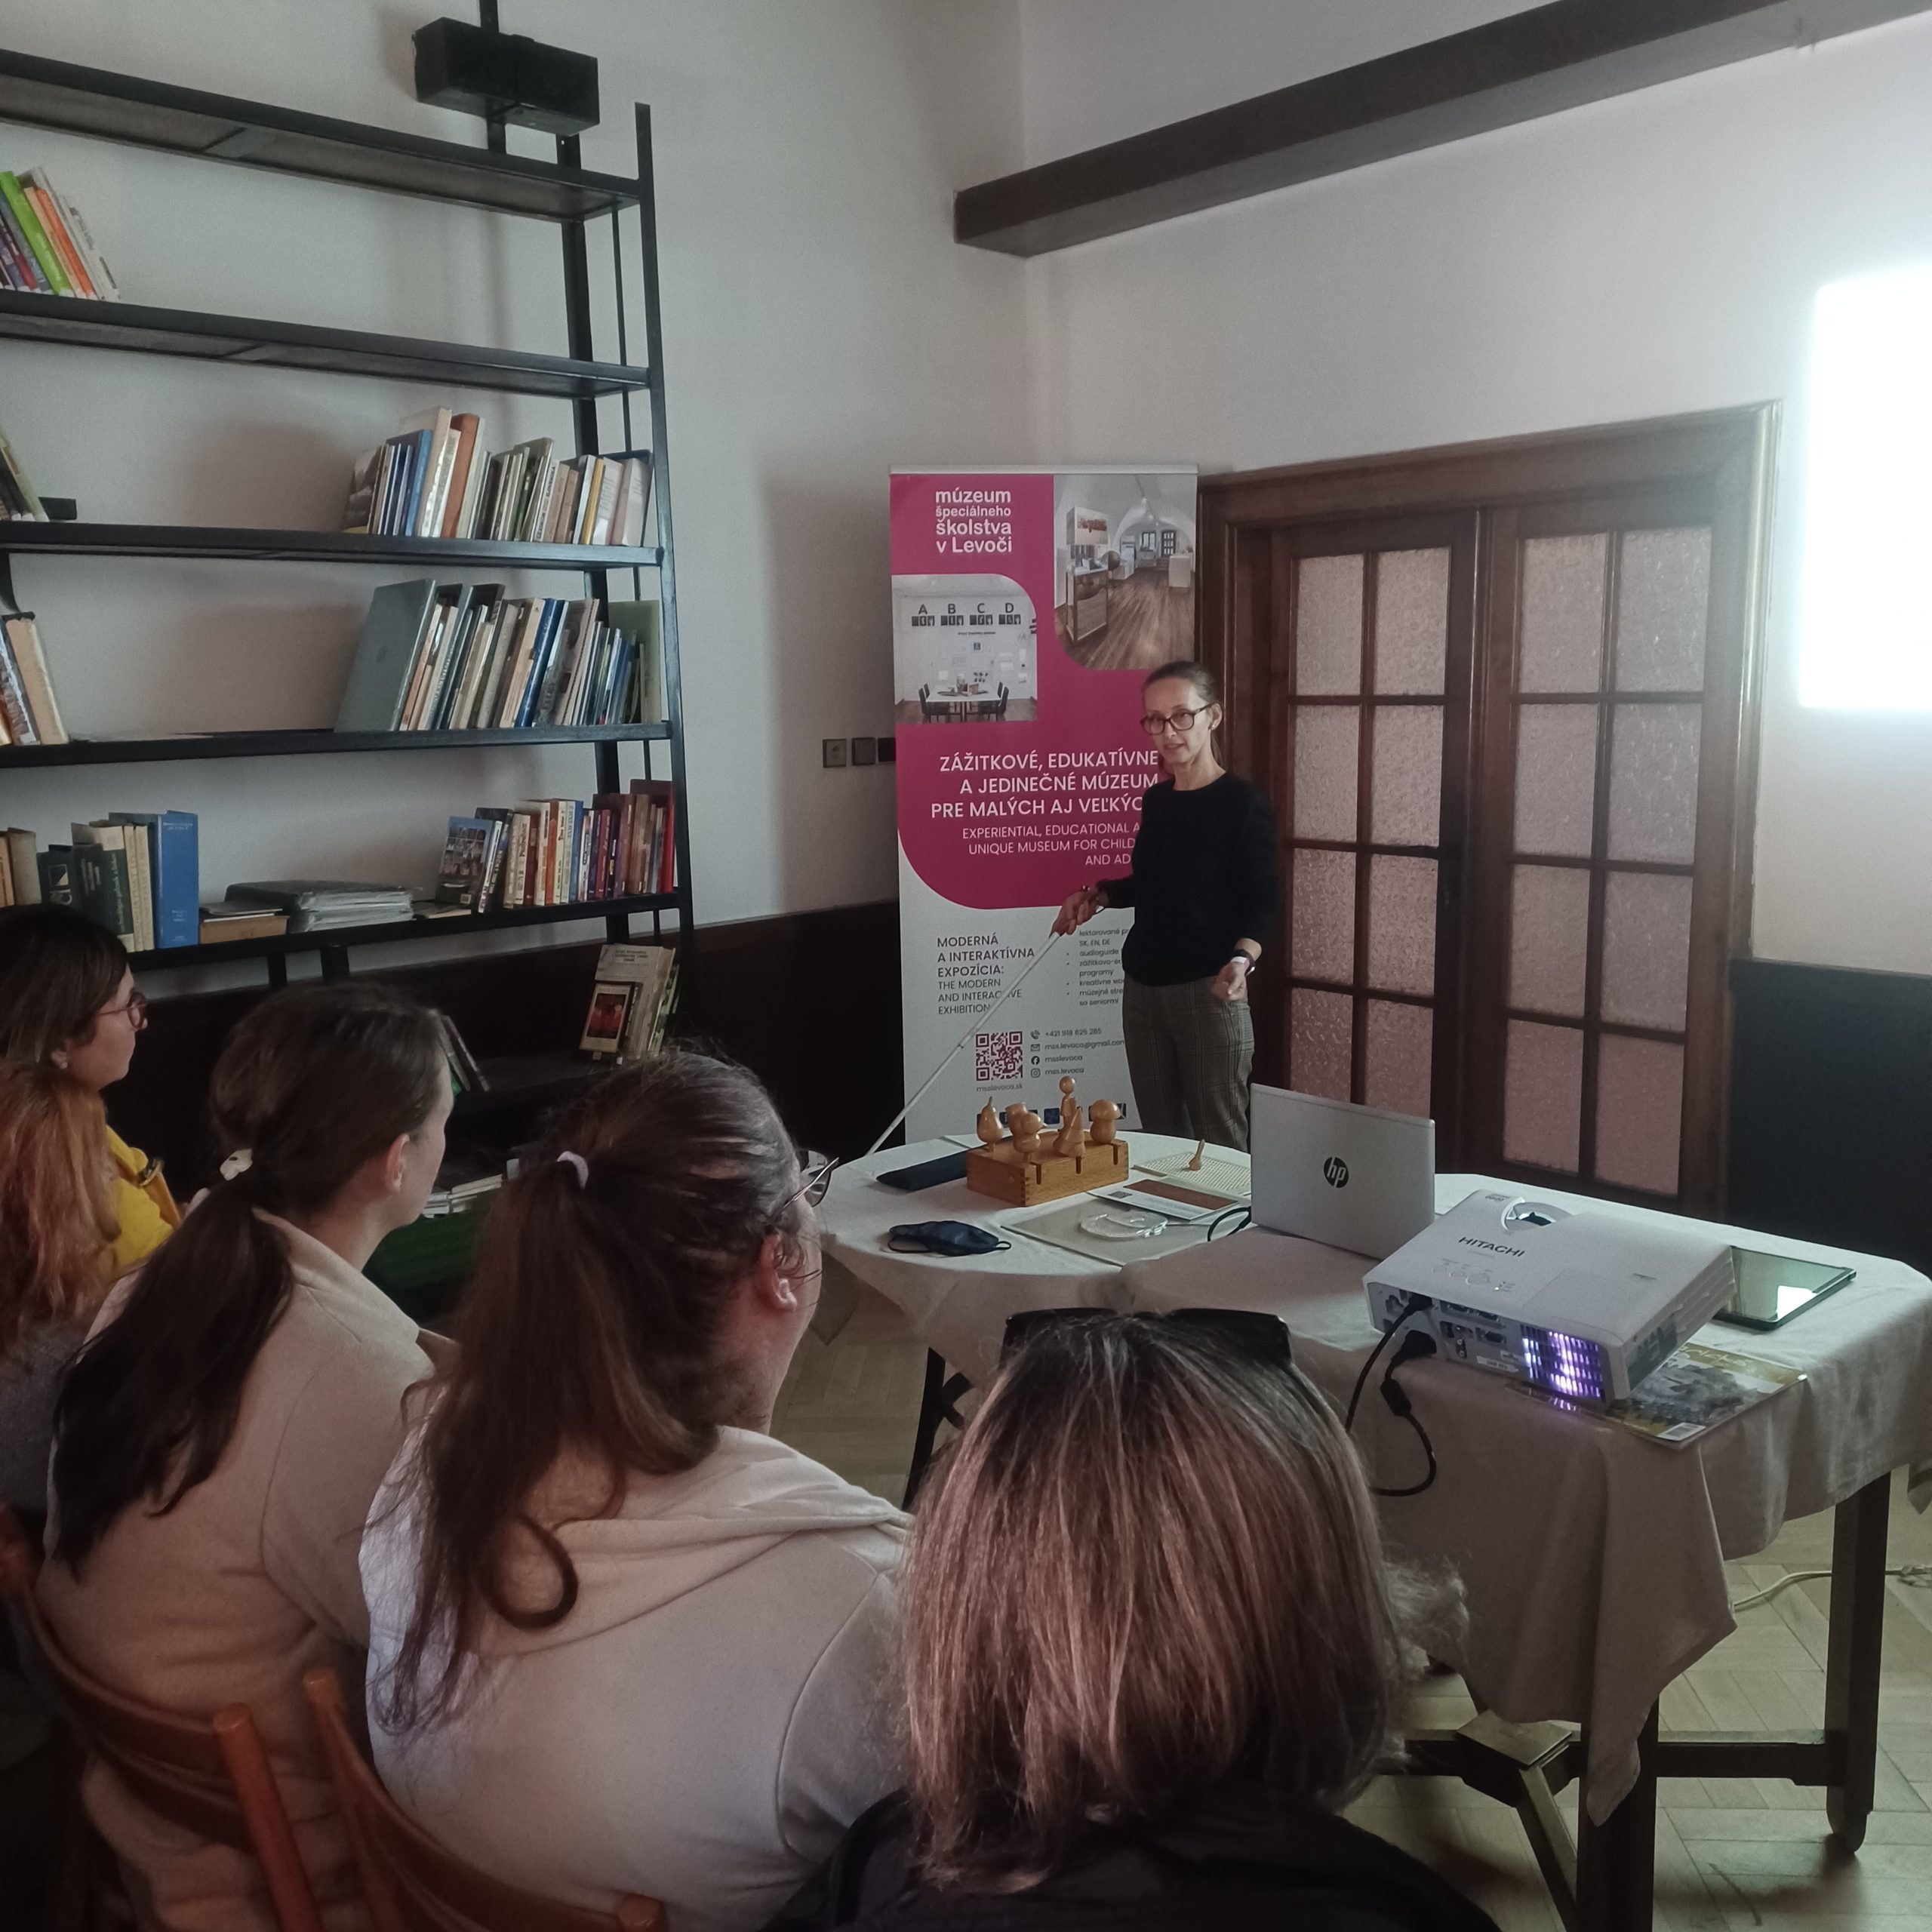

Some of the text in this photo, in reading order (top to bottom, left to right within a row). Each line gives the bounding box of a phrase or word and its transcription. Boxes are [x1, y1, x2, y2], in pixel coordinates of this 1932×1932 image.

[936, 487, 1011, 503] múzeum
[936, 505, 1011, 518] špeciálneho
[936, 518, 1011, 535] školstva
[936, 536, 1012, 553] v Levoči
[918, 602, 1014, 614] A B C D
[940, 747, 1159, 772] ZÁŽITKOVÉ, EDUKATÍVNE
[960, 771, 1159, 795] A JEDINEČNÉ MÚZEUM
[931, 792, 1143, 818] PRE MALÝCH AJ VEĽKÝC
[962, 822, 1140, 840] EXPERIENTIAL, EDUCATIONAL A
[969, 838, 1136, 855] UNIQUE MUSEUM FOR CHILD
[1084, 854, 1132, 866] AND AD
[937, 932, 998, 948] MODERNÁ
[937, 946, 1035, 962] A INTERAKTÍVNA
[938, 963, 1004, 977] EXPOZÍCIA:
[1079, 969, 1114, 978] programy
[938, 979, 1001, 990] THE MODERN
[938, 989, 1022, 1002] AND INTERACVE
[938, 1004, 990, 1014] EXHIBITION
[1325, 1157, 1348, 1188] hp
[1458, 1236, 1526, 1258] HITACHI
